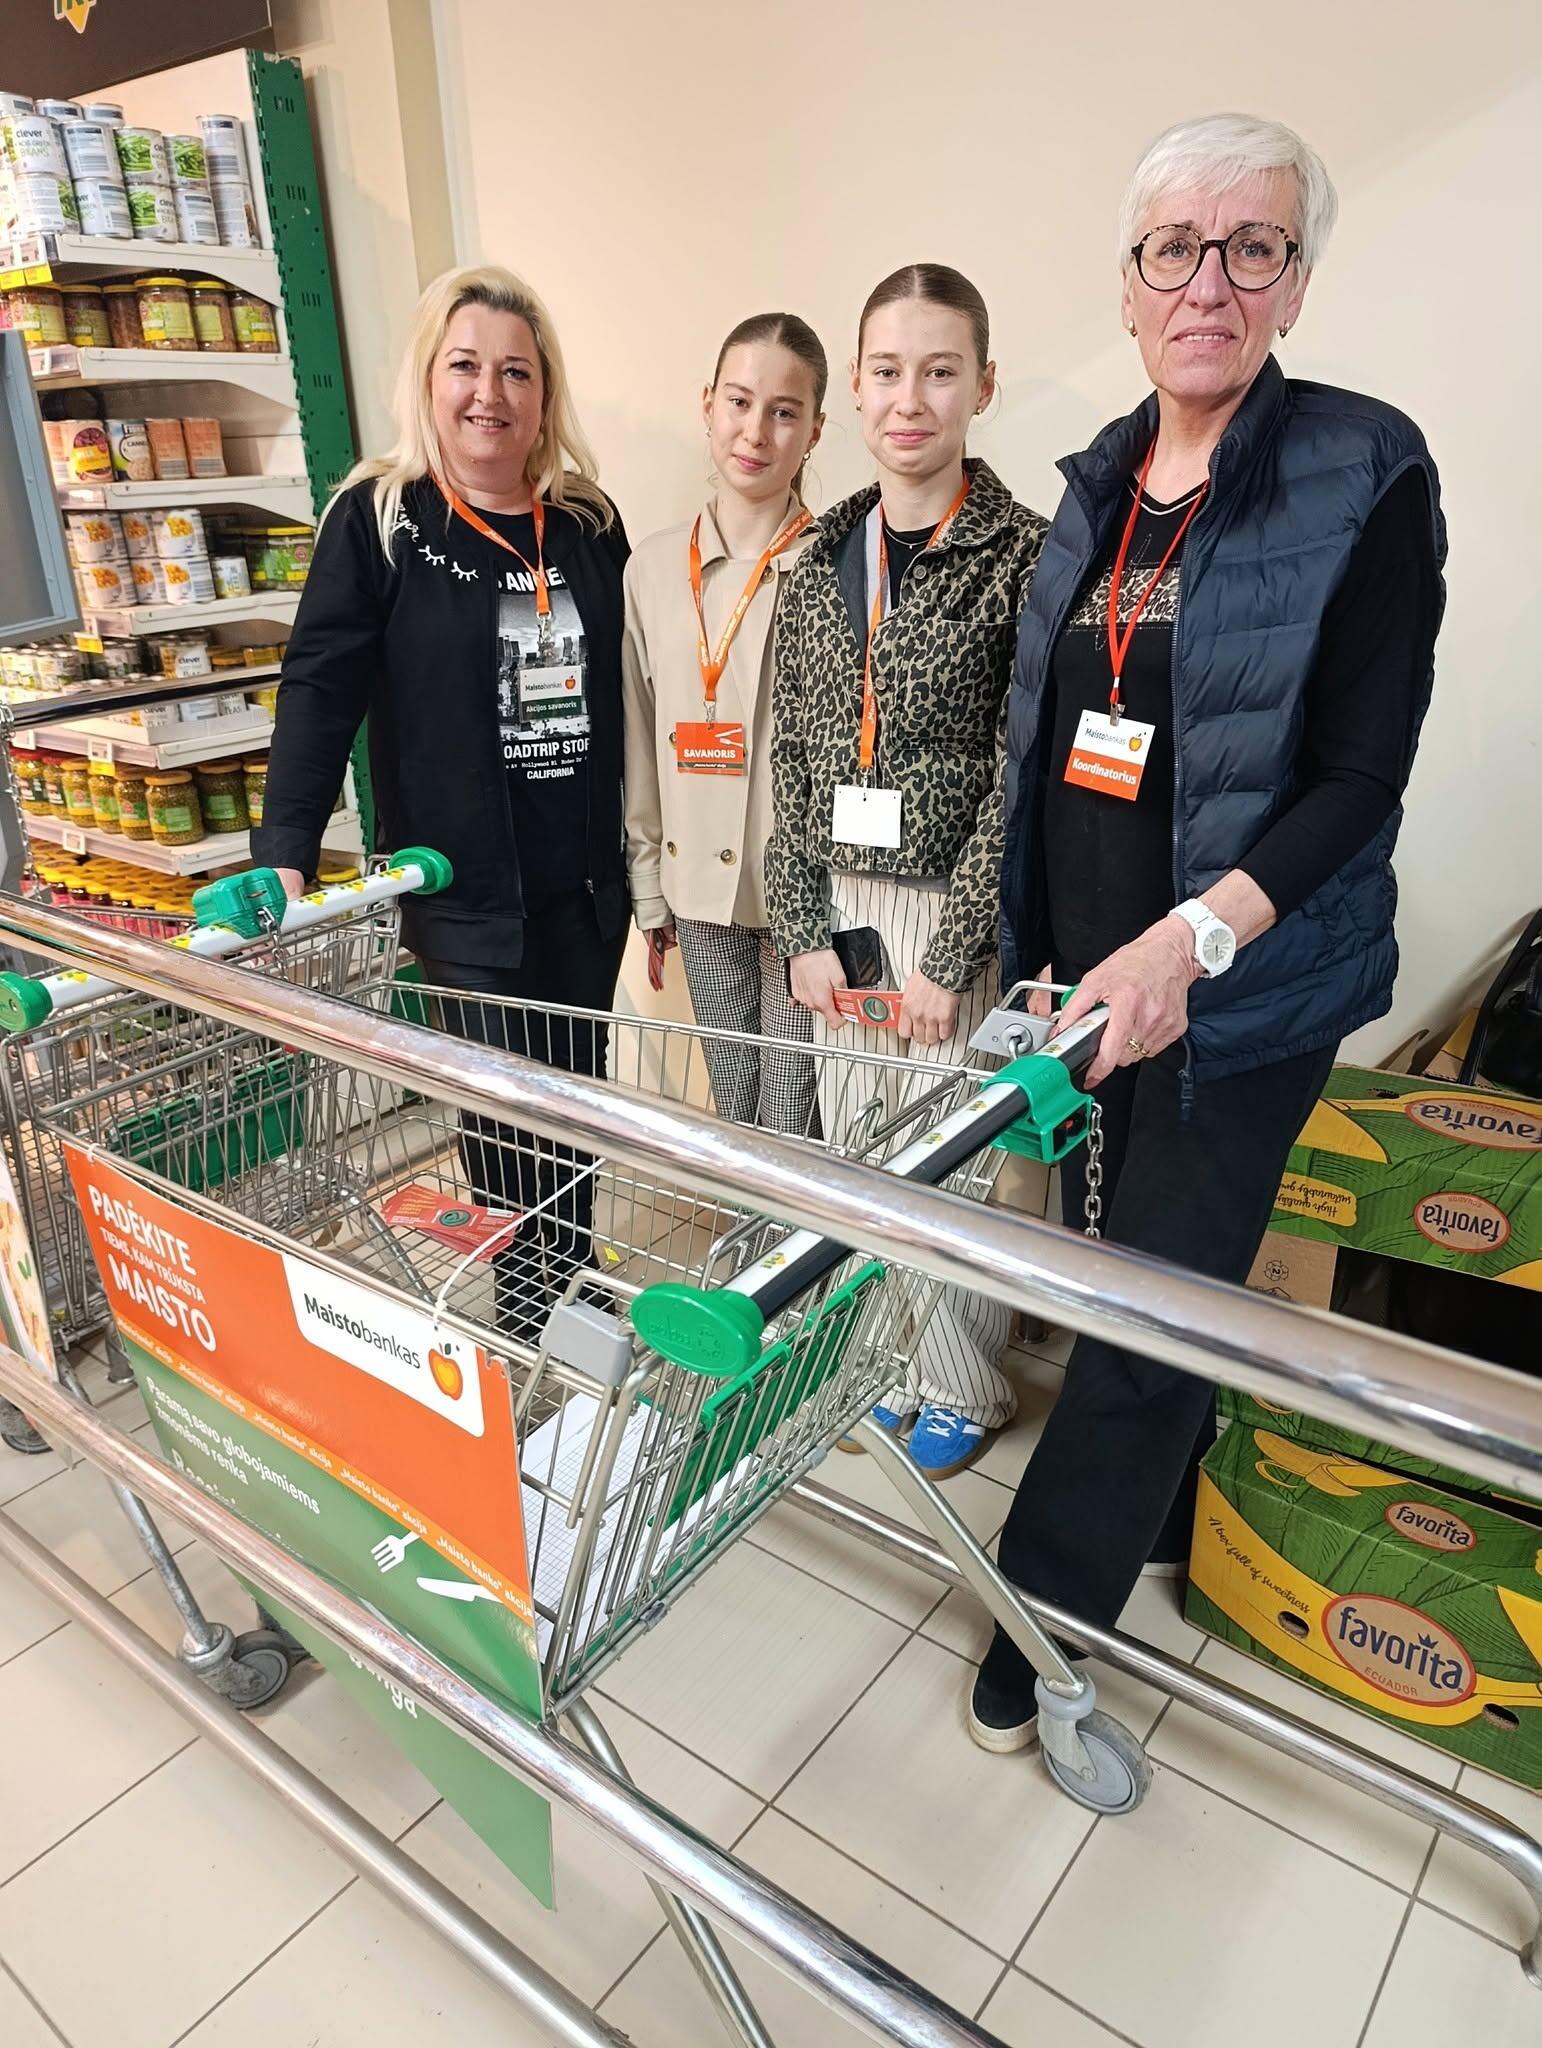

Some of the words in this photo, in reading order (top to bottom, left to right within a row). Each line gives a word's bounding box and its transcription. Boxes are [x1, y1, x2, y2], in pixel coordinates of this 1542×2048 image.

[526, 704, 548, 714] Akcijos
[547, 701, 577, 711] savanoris
[503, 741, 560, 760] OADTRIP
[1085, 728, 1126, 745] Maistobankas
[683, 748, 737, 759] SAVANORIS
[526, 766, 575, 780] CALIFORNIA
[1072, 757, 1138, 785] Koordinatorius
[1277, 1193, 1312, 1209] quality
[1297, 1183, 1352, 1205] sustainably
[1312, 1201, 1338, 1218] High
[1422, 1203, 1501, 1243] favorita
[88, 1183, 197, 1276] PADĖKITE
[108, 1253, 217, 1352] MAISTO
[303, 1292, 421, 1369] Maistobankas
[191, 1414, 221, 1444] savo
[222, 1435, 320, 1515] globojamiems
[210, 1448, 249, 1485] renka
[1396, 1505, 1470, 1546] favorita
[1215, 1527, 1233, 1547] box
[1226, 1546, 1252, 1568] full
[1249, 1566, 1262, 1581] of
[1261, 1575, 1312, 1614] sweetness
[504, 1589, 534, 1619] akcija
[1338, 1606, 1463, 1690] favorita
[1363, 1666, 1419, 1697] ECUADOR
